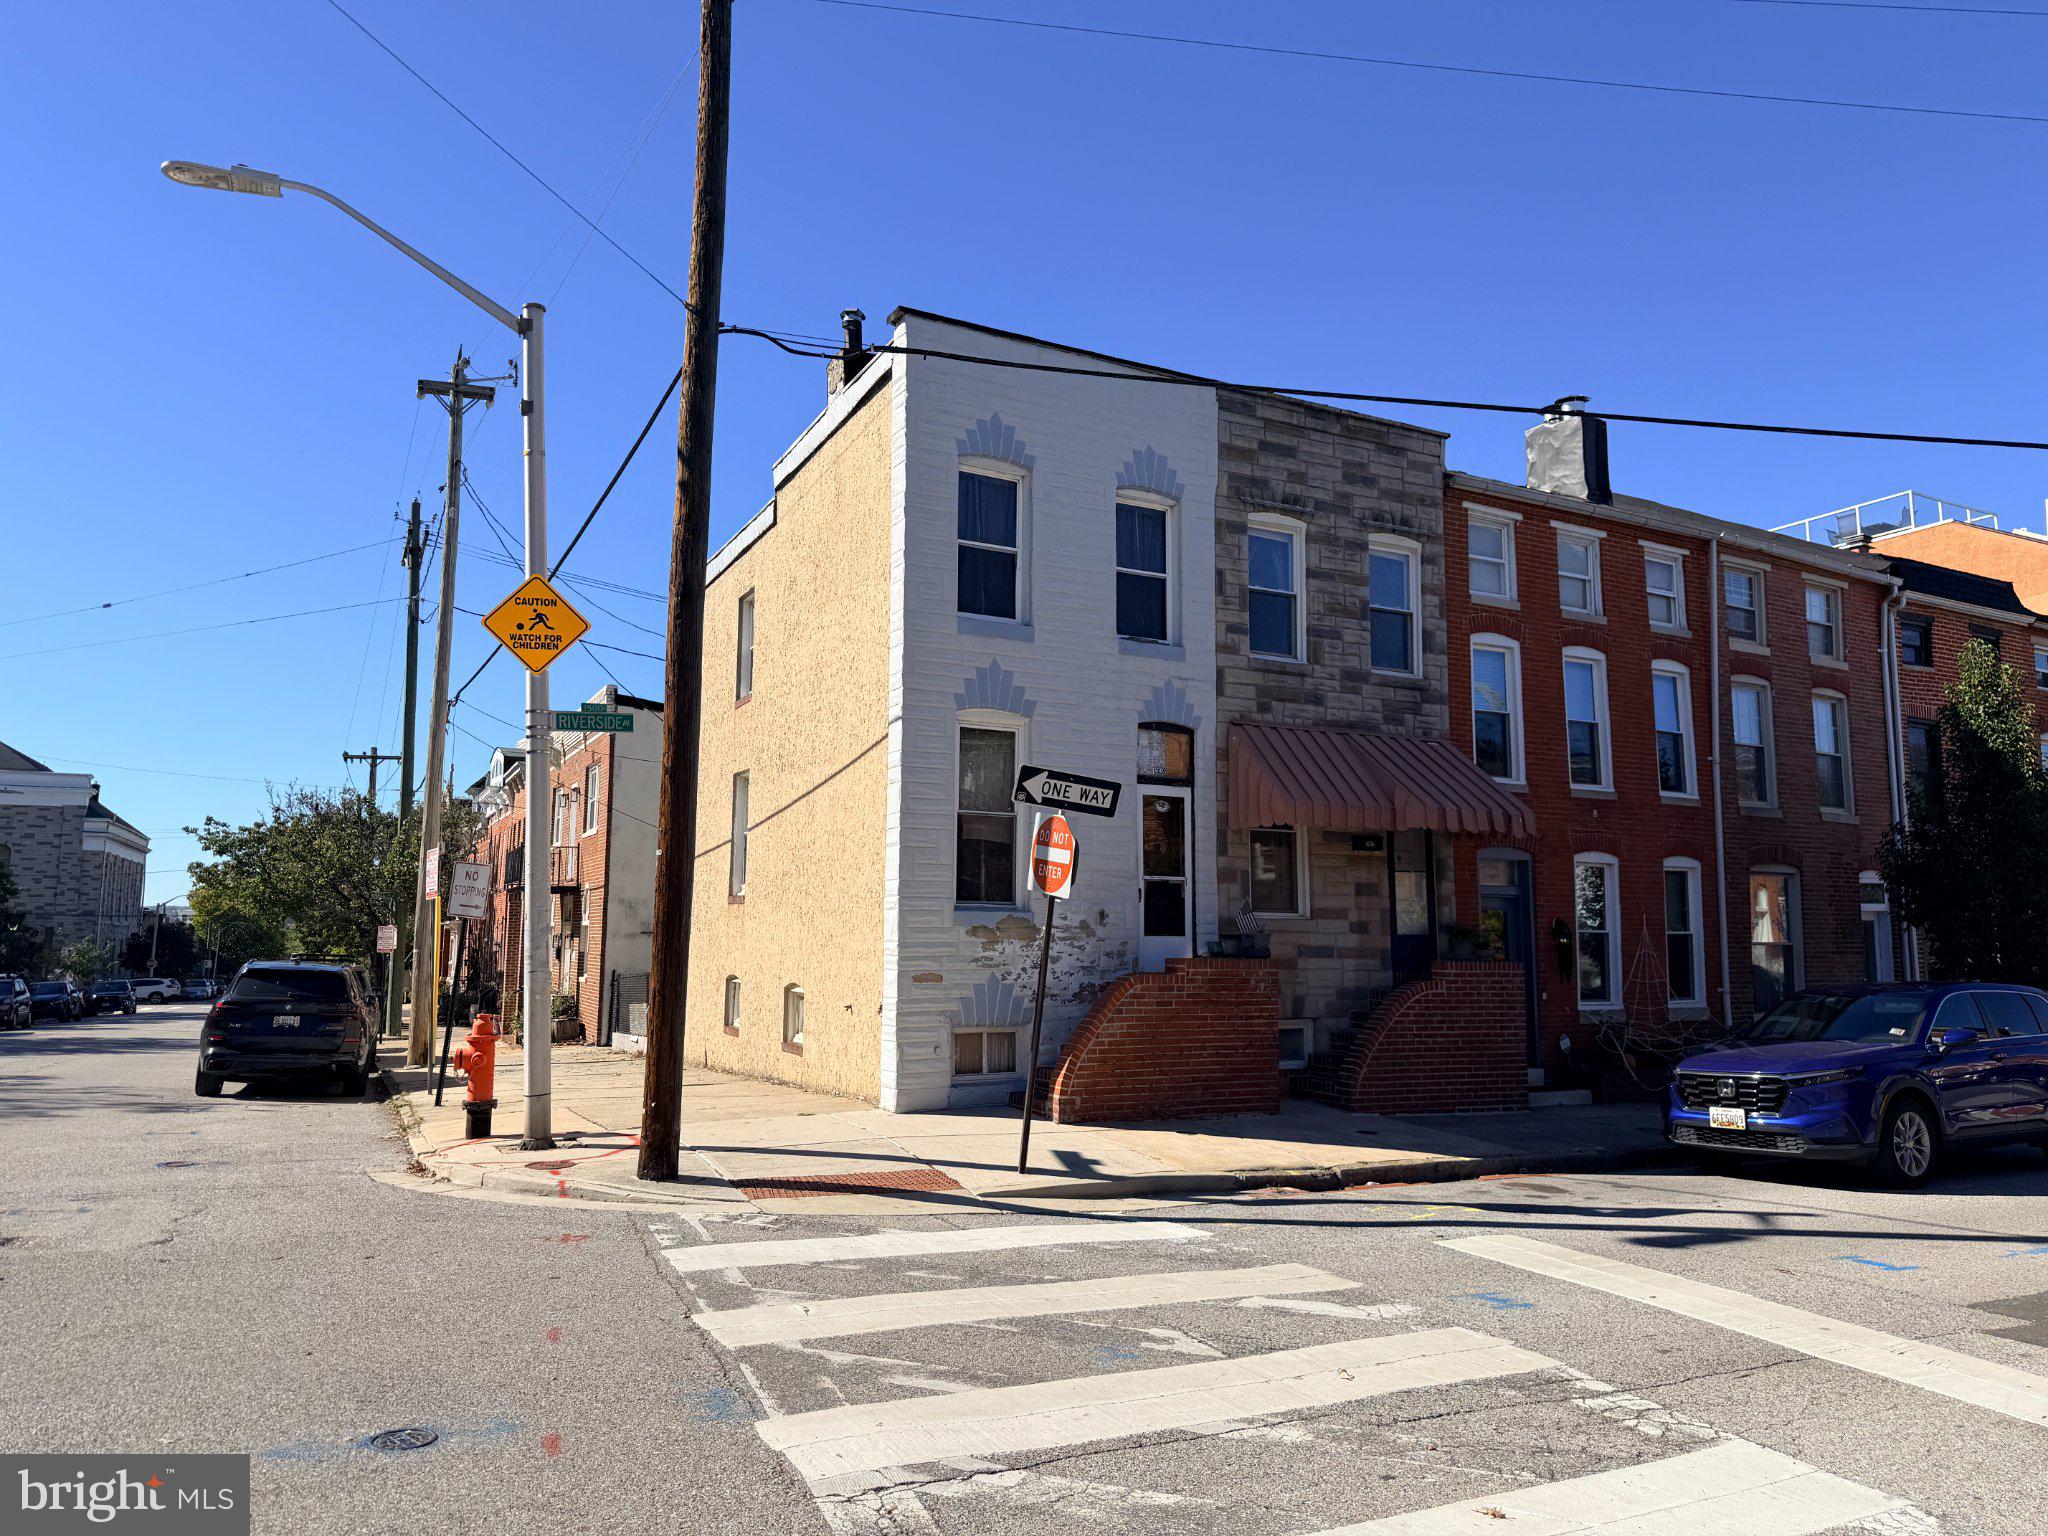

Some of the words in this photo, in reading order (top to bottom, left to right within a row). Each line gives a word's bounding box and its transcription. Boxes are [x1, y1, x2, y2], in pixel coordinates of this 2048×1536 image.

[514, 597, 558, 607] CAUTION
[509, 633, 542, 642] WATCH
[544, 634, 562, 643] FOR
[512, 641, 559, 651] CHILDREN
[559, 714, 623, 730] RIVERSIDE
[1041, 781, 1073, 799] ONE
[1079, 787, 1111, 805] WAY
[1039, 829, 1050, 842] DO
[1052, 831, 1069, 845] NOT
[464, 870, 479, 881] NO
[1038, 863, 1063, 880] ENTER
[453, 884, 486, 897] STOPPING
